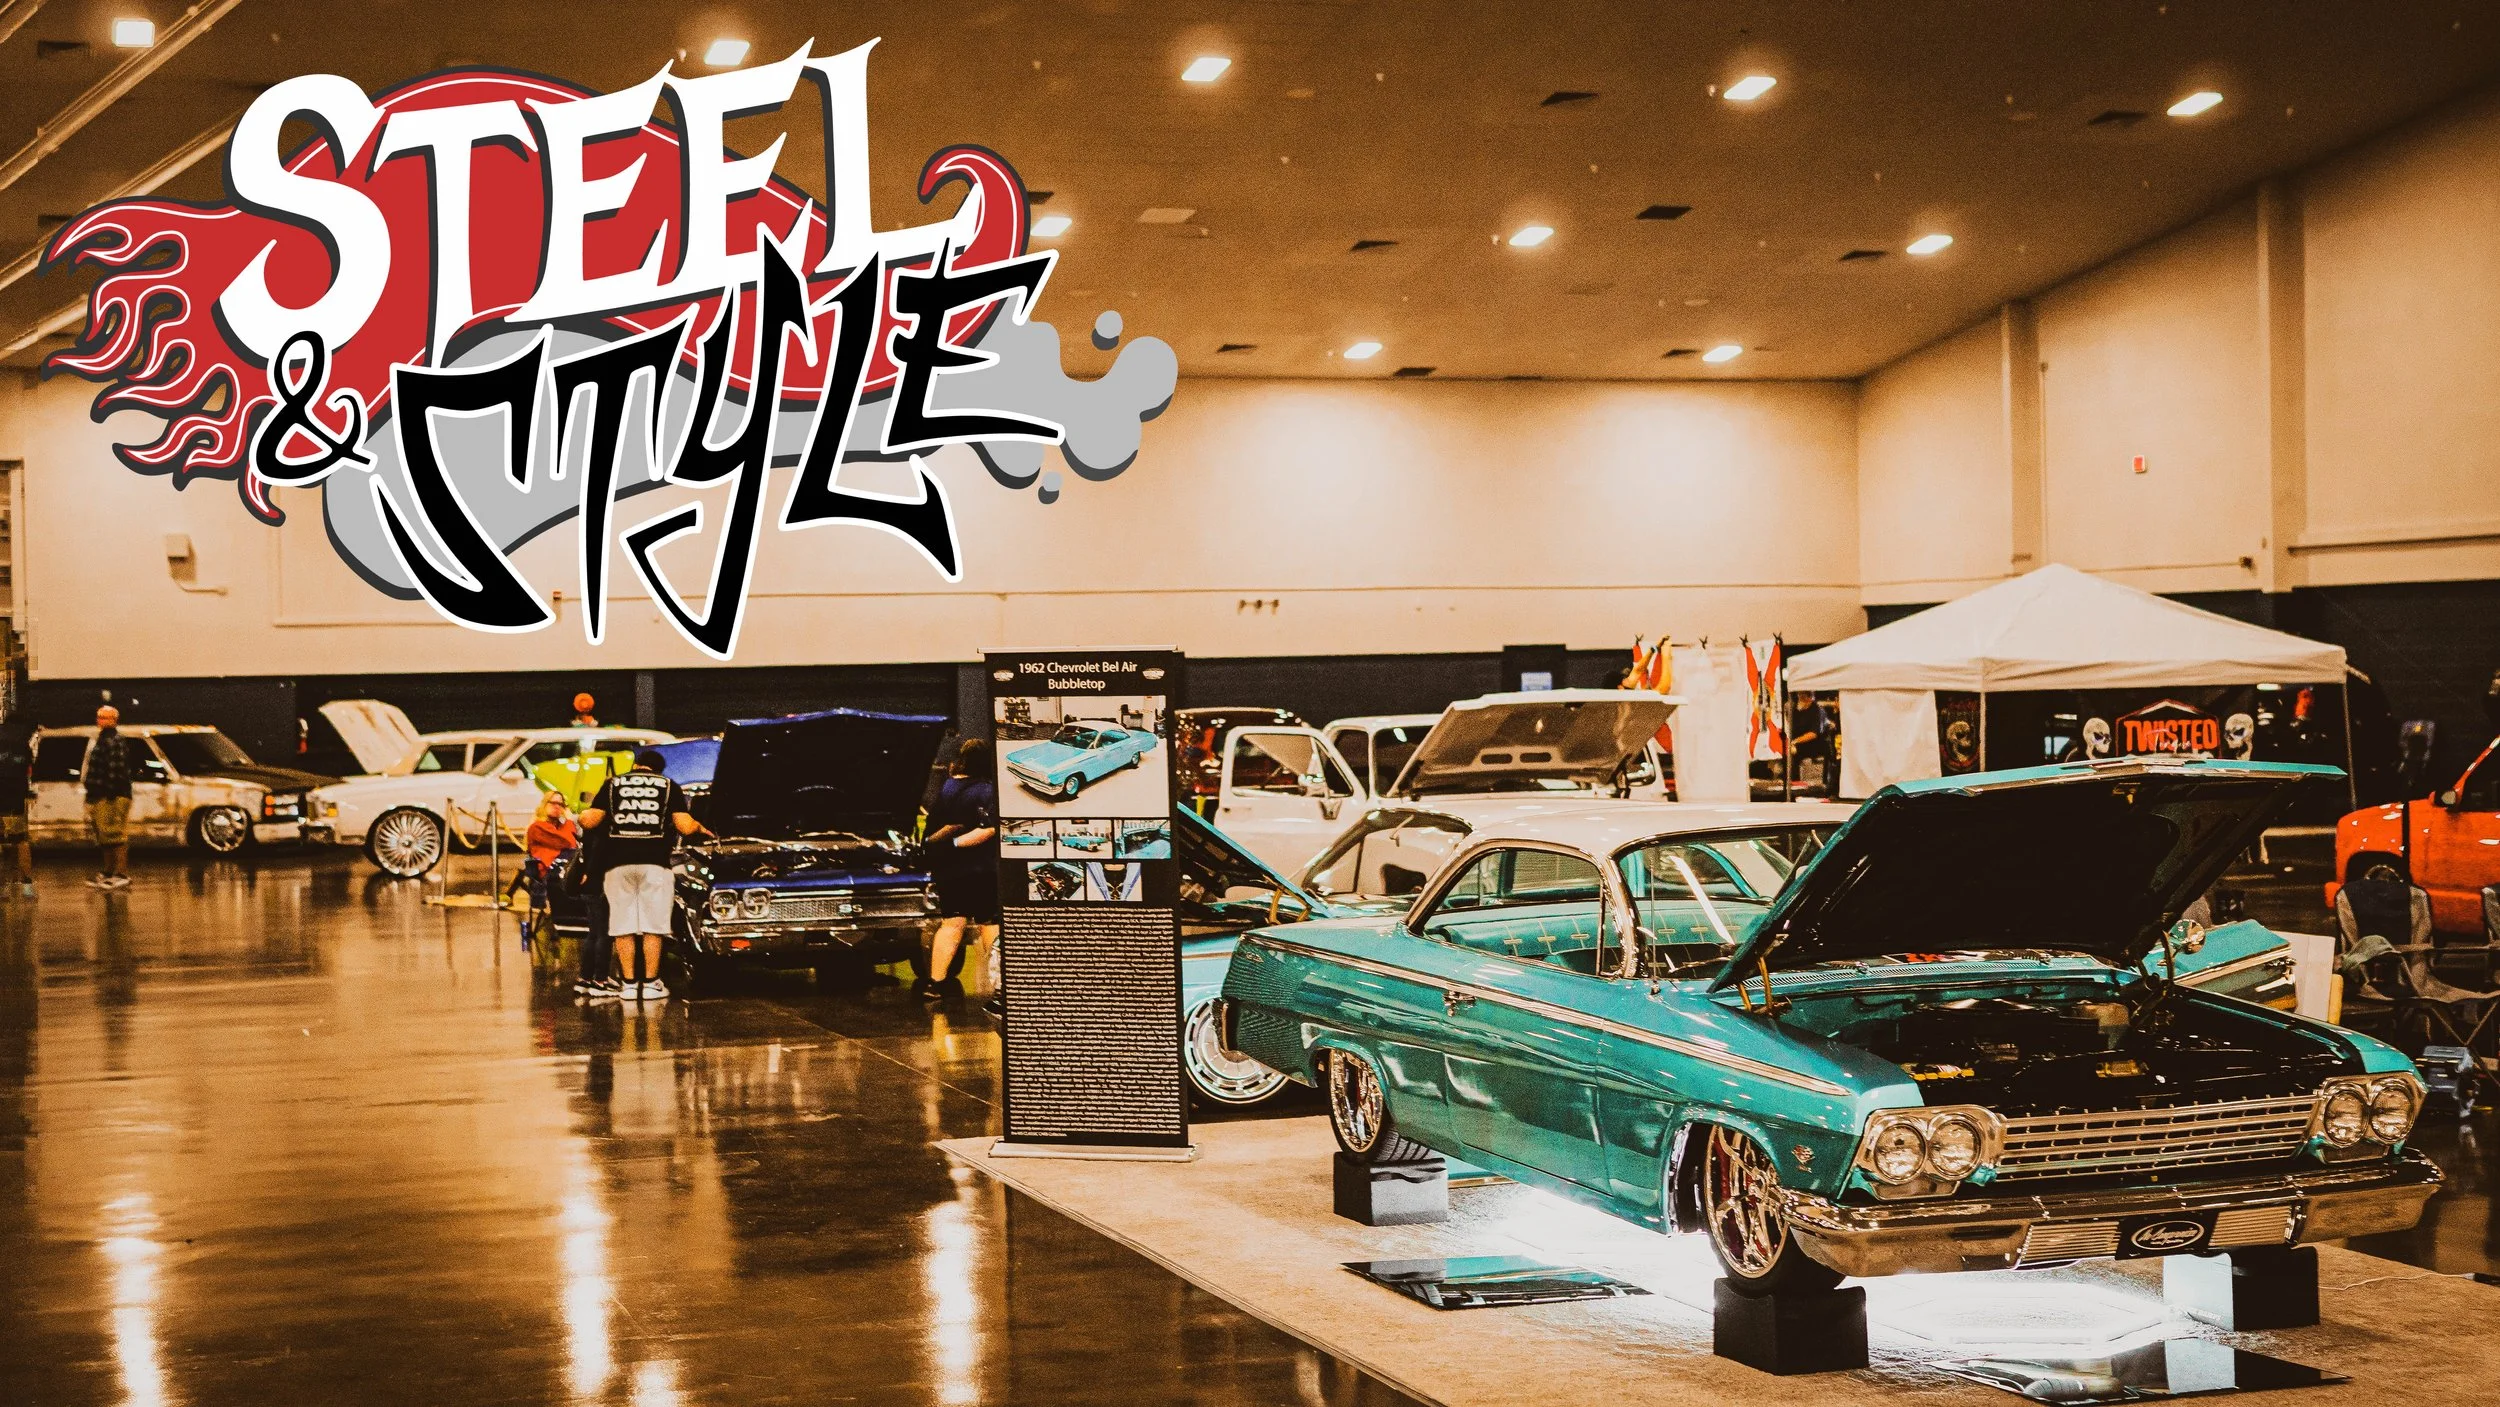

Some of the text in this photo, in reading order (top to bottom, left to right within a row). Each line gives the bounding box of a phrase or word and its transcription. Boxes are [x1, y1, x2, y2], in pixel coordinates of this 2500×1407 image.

[1018, 661, 1138, 674] 1962 Chevrolet Bel Air
[1048, 678, 1106, 691] Bubbletop
[2123, 718, 2219, 752] TWISTED
[620, 775, 667, 788] LOVE
[618, 787, 659, 798] GOD
[618, 799, 660, 811] AND
[613, 812, 660, 825] CARS
